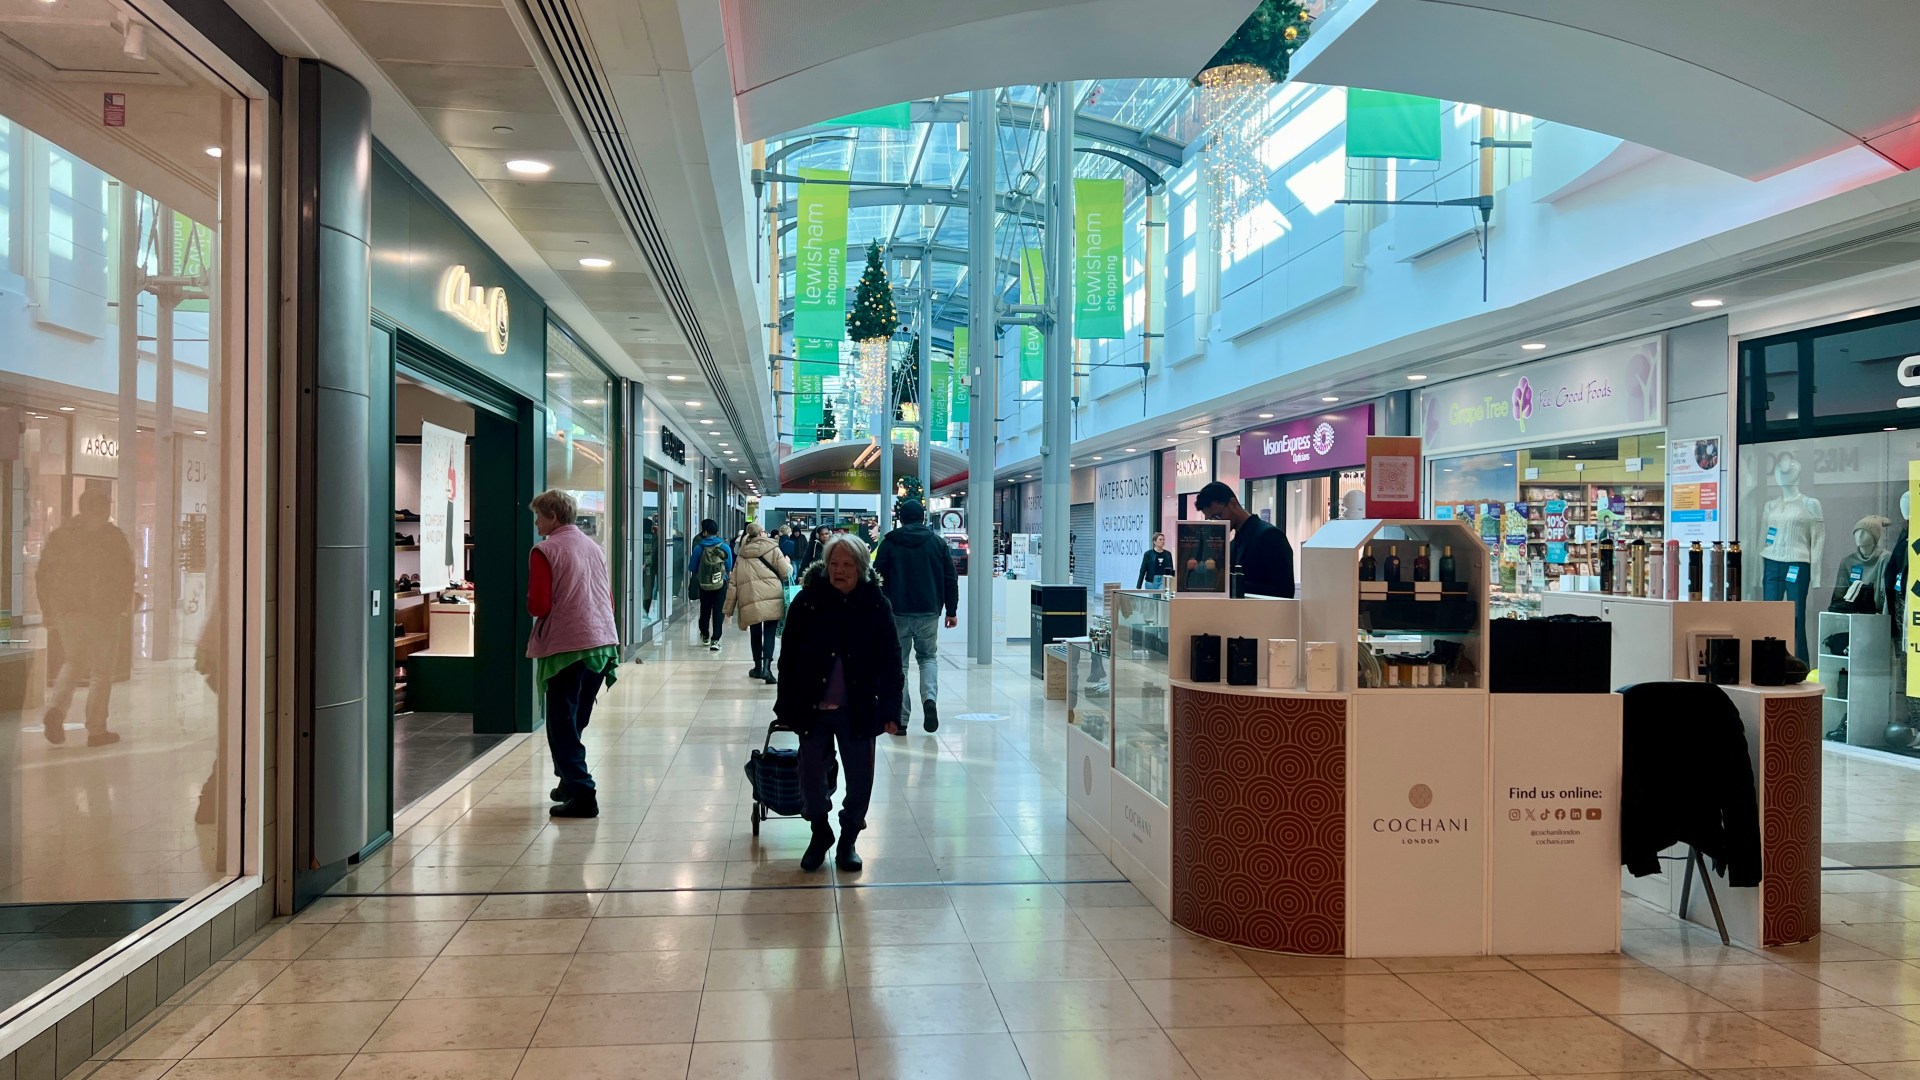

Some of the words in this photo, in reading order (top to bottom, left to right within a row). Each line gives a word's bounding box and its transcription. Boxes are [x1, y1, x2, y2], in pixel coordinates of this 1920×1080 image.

[801, 203, 823, 304] lewisham
[1083, 213, 1101, 312] lewisham
[825, 248, 840, 305] shopping
[1106, 255, 1118, 311] shopping
[1449, 402, 1483, 427] Grape
[1484, 396, 1509, 418] Tree
[1099, 476, 1149, 500] WATERSTONES
[1102, 517, 1112, 532] NEW
[1114, 515, 1143, 531] BOOKSHOP
[1546, 515, 1564, 528] 10%
[1547, 527, 1564, 540] OFF
[1102, 540, 1123, 555] OPENING
[1125, 540, 1143, 556] SOON
[1509, 787, 1537, 799] Find
[1540, 790, 1555, 799] us
[1559, 787, 1602, 799] online:
[1373, 818, 1468, 833] COCHANI
[1530, 829, 1580, 837] @cochanilondon
